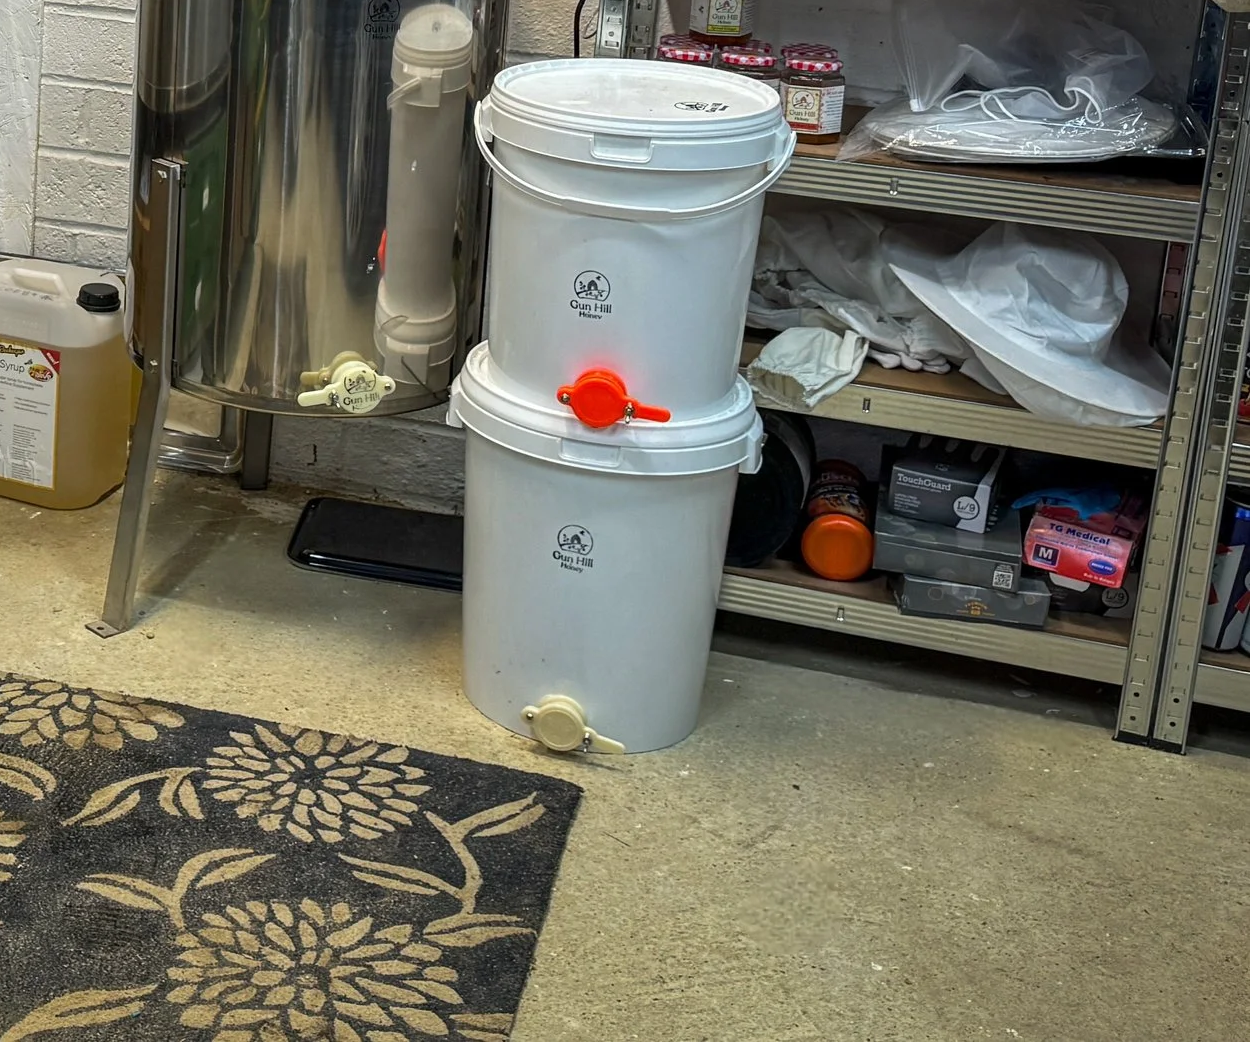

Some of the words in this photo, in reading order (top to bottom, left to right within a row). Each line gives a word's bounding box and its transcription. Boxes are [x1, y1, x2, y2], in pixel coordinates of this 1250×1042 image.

[570, 299, 592, 311] Gun
[594, 303, 612, 314] Hill
[0, 359, 25, 374] Syrup
[342, 396, 363, 405] Gun
[897, 473, 952, 491] TouchGuard
[957, 501, 976, 513] L/9
[1050, 523, 1063, 532] TG
[1065, 527, 1111, 546] Medical
[552, 550, 574, 564] Gun
[576, 556, 594, 568] Hill
[1038, 547, 1053, 560] M
